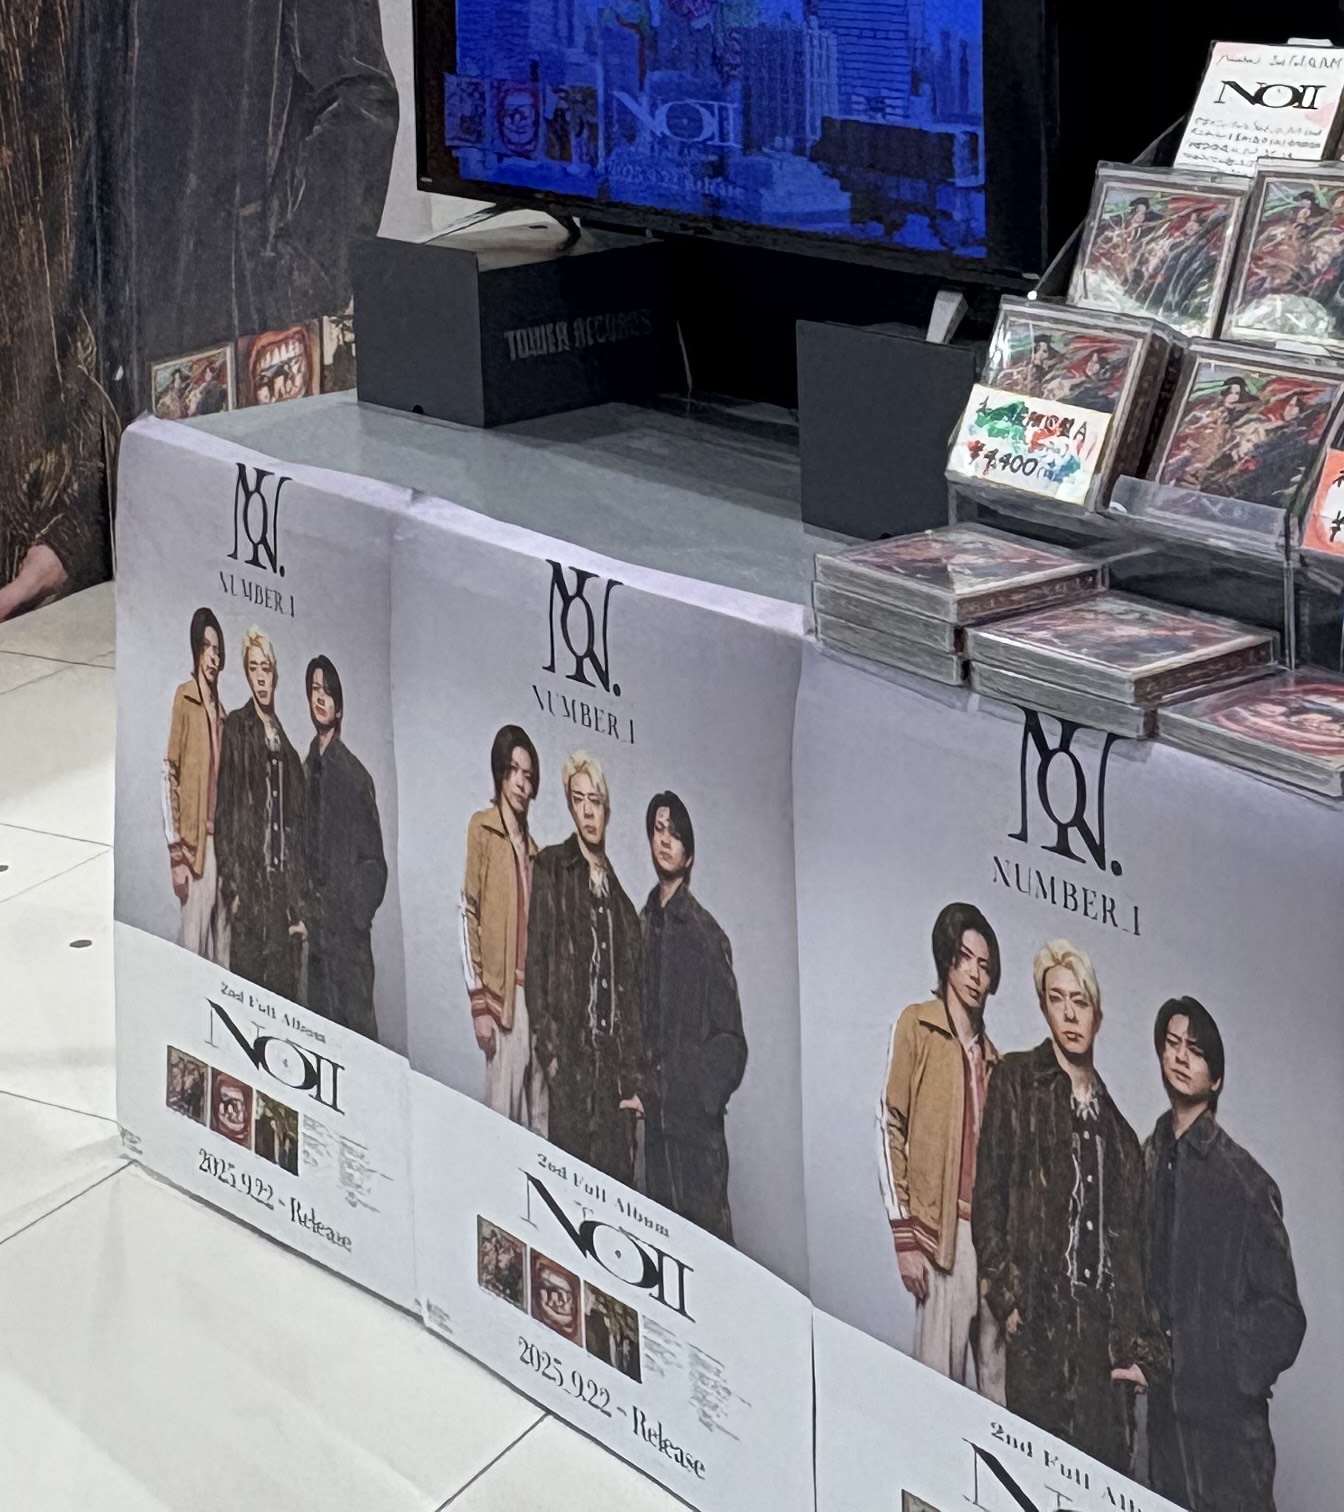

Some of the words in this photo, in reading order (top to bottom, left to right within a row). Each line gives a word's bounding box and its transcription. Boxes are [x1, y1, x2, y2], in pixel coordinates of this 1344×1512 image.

[615, 1197, 670, 1238] Album
[632, 1404, 707, 1480] Release
[990, 1421, 1033, 1458] 2nd
[1043, 1449, 1090, 1490] Full
